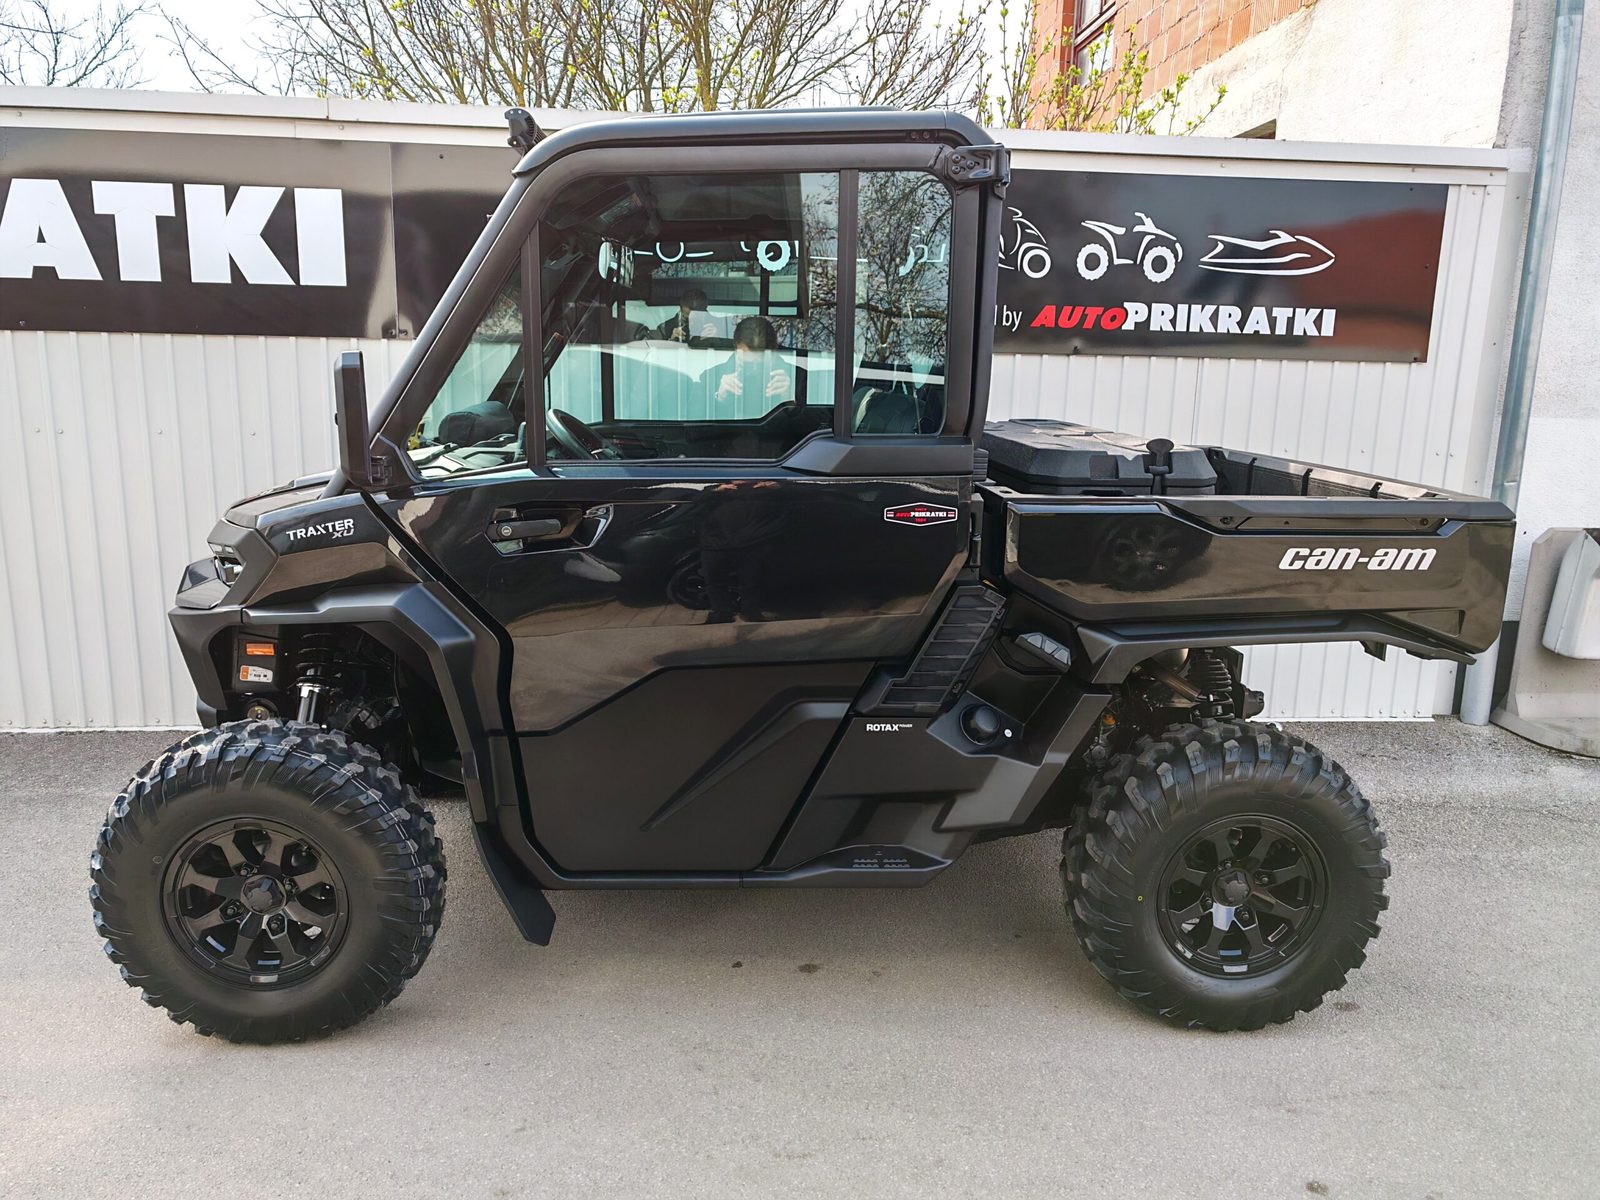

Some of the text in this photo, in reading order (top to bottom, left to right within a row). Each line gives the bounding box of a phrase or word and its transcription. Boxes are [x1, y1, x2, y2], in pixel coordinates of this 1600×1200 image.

[1002, 304, 1022, 332] by
[1030, 301, 1337, 337] AUTOPRIKRATKI
[286, 518, 355, 541] TRAXTER
[1278, 547, 1437, 571] can-am
[866, 723, 899, 732] ROTAX
